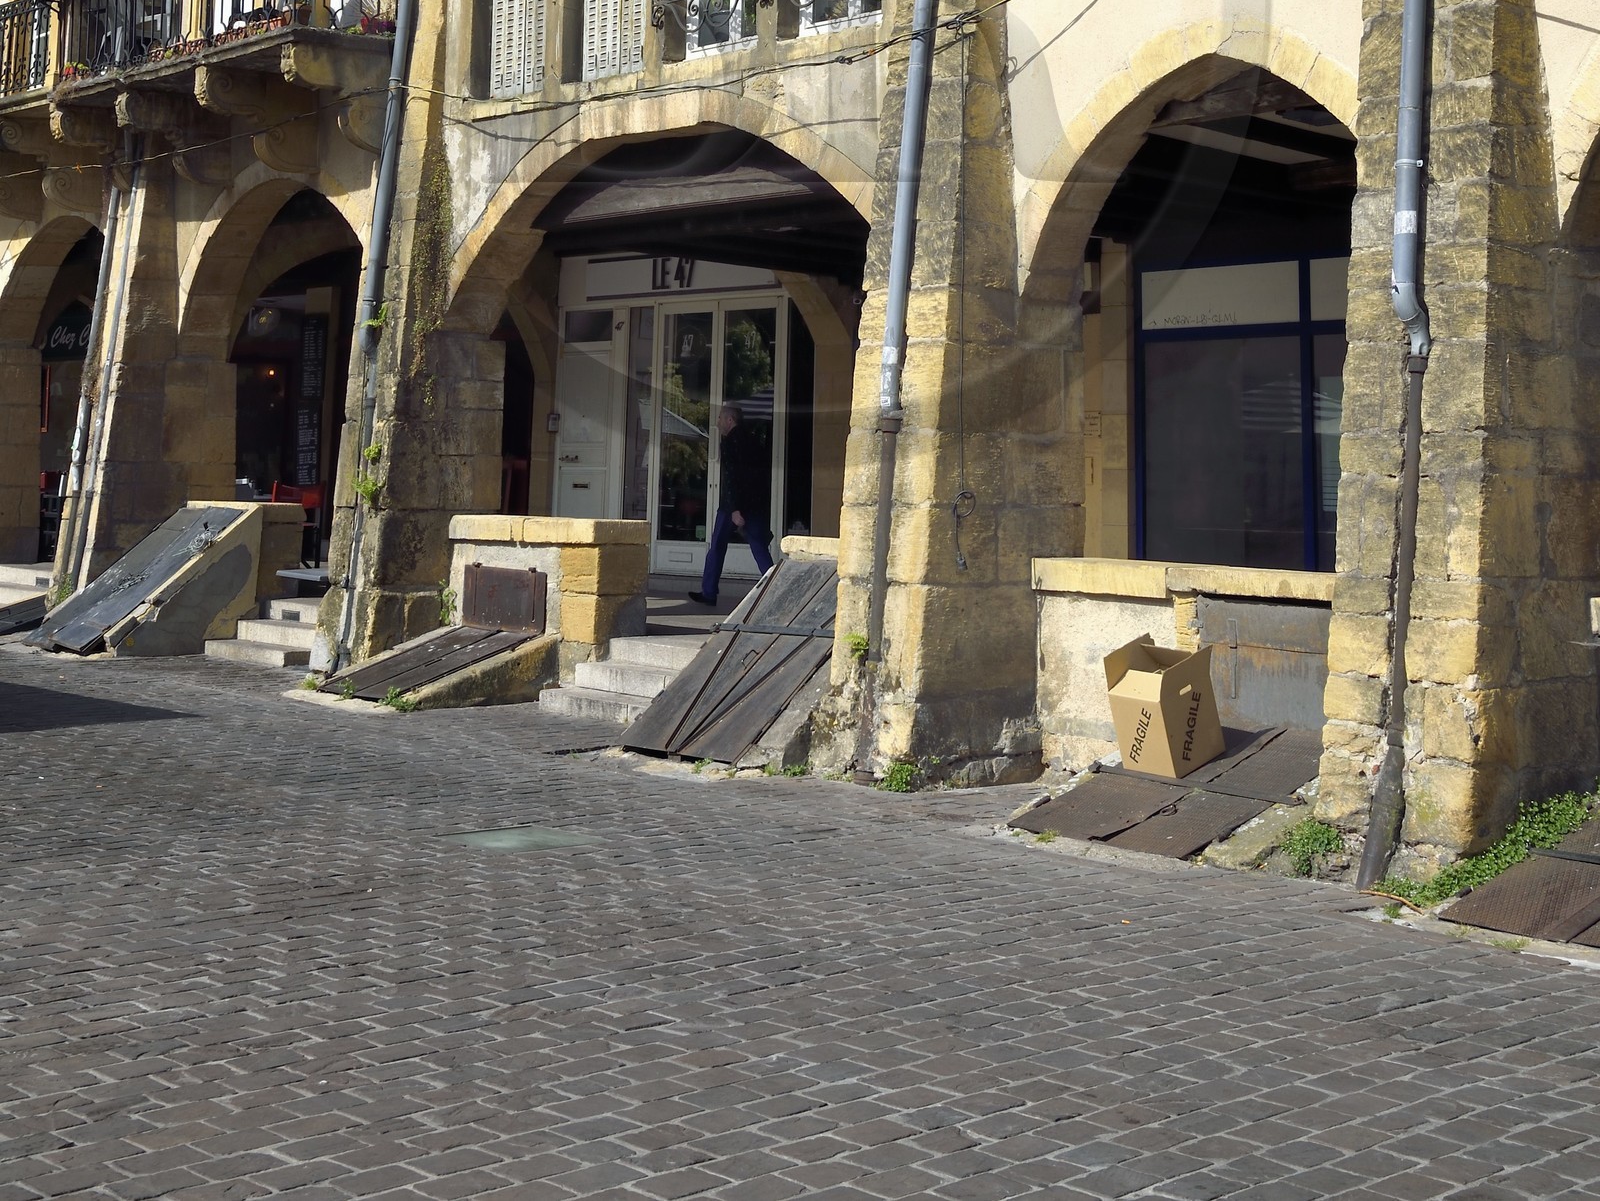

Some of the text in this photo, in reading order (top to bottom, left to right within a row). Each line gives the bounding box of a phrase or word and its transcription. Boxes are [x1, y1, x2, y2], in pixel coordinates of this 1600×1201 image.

[652, 256, 696, 290] LE 47
[51, 323, 91, 350] Chez C
[615, 321, 625, 331] 47
[1129, 707, 1152, 763] FRAGILE
[1181, 691, 1202, 761] FRAGILE
